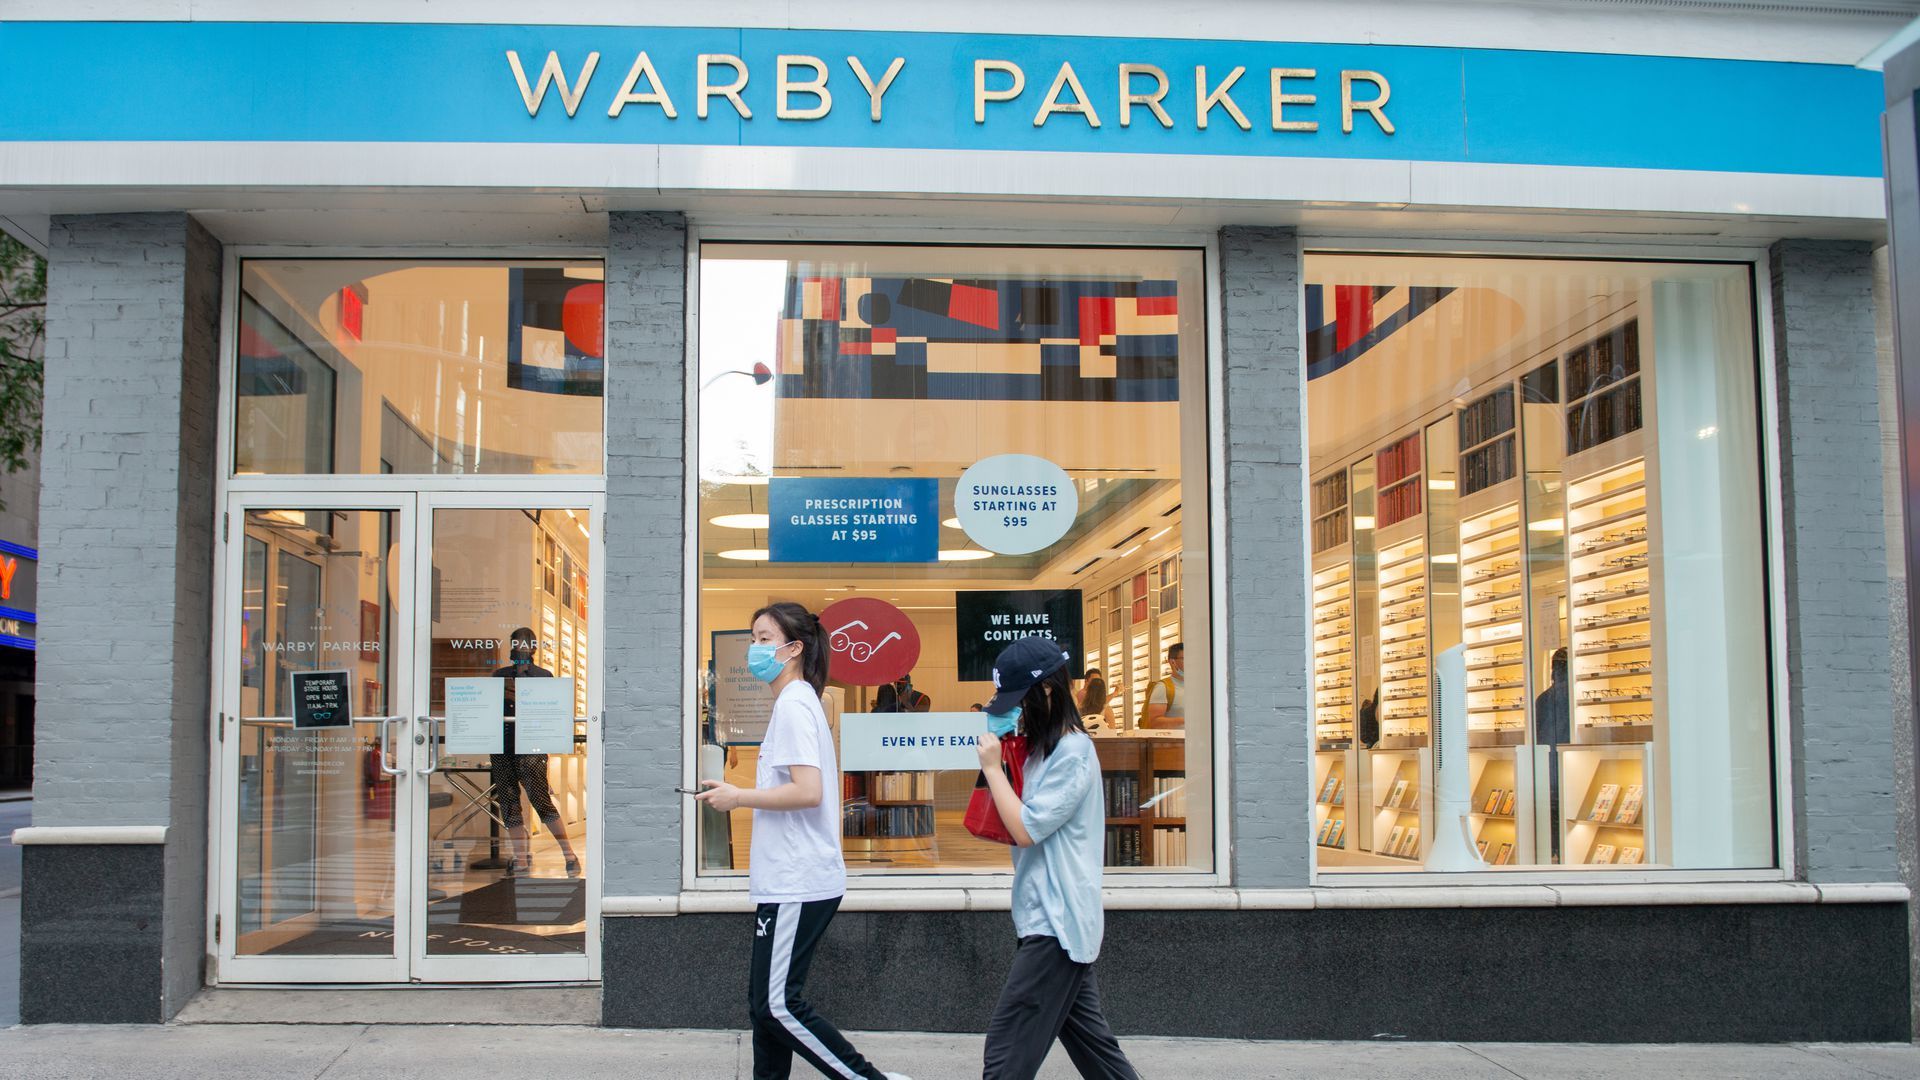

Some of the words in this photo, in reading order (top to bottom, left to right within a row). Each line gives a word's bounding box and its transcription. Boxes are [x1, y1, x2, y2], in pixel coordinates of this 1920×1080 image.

[506, 50, 906, 121] WARBY
[974, 58, 1396, 134] PARKER
[973, 485, 1057, 496] SUNGLASSES
[805, 498, 903, 510] PRESCRIPTION
[973, 501, 1037, 511] STARTING
[1042, 501, 1057, 511] AT
[790, 514, 849, 526] GLASSES
[853, 514, 918, 525] STARTING
[1003, 515, 1028, 527] $95
[831, 530, 847, 541] AT
[852, 530, 877, 541] $95
[990, 614, 1010, 625] WE
[1015, 613, 1050, 625] HAVE
[983, 629, 1057, 641] CONTACTS,
[262, 641, 316, 652] WARBY
[323, 641, 381, 652] PARKER
[450, 639, 504, 649] WARBY
[882, 736, 916, 747] EVEN
[921, 736, 945, 746] EYE
[950, 735, 980, 746] EXA
[265, 745, 300, 753] SATURDAY
[358, 930, 444, 942] NIE
[448, 937, 490, 947] TO
